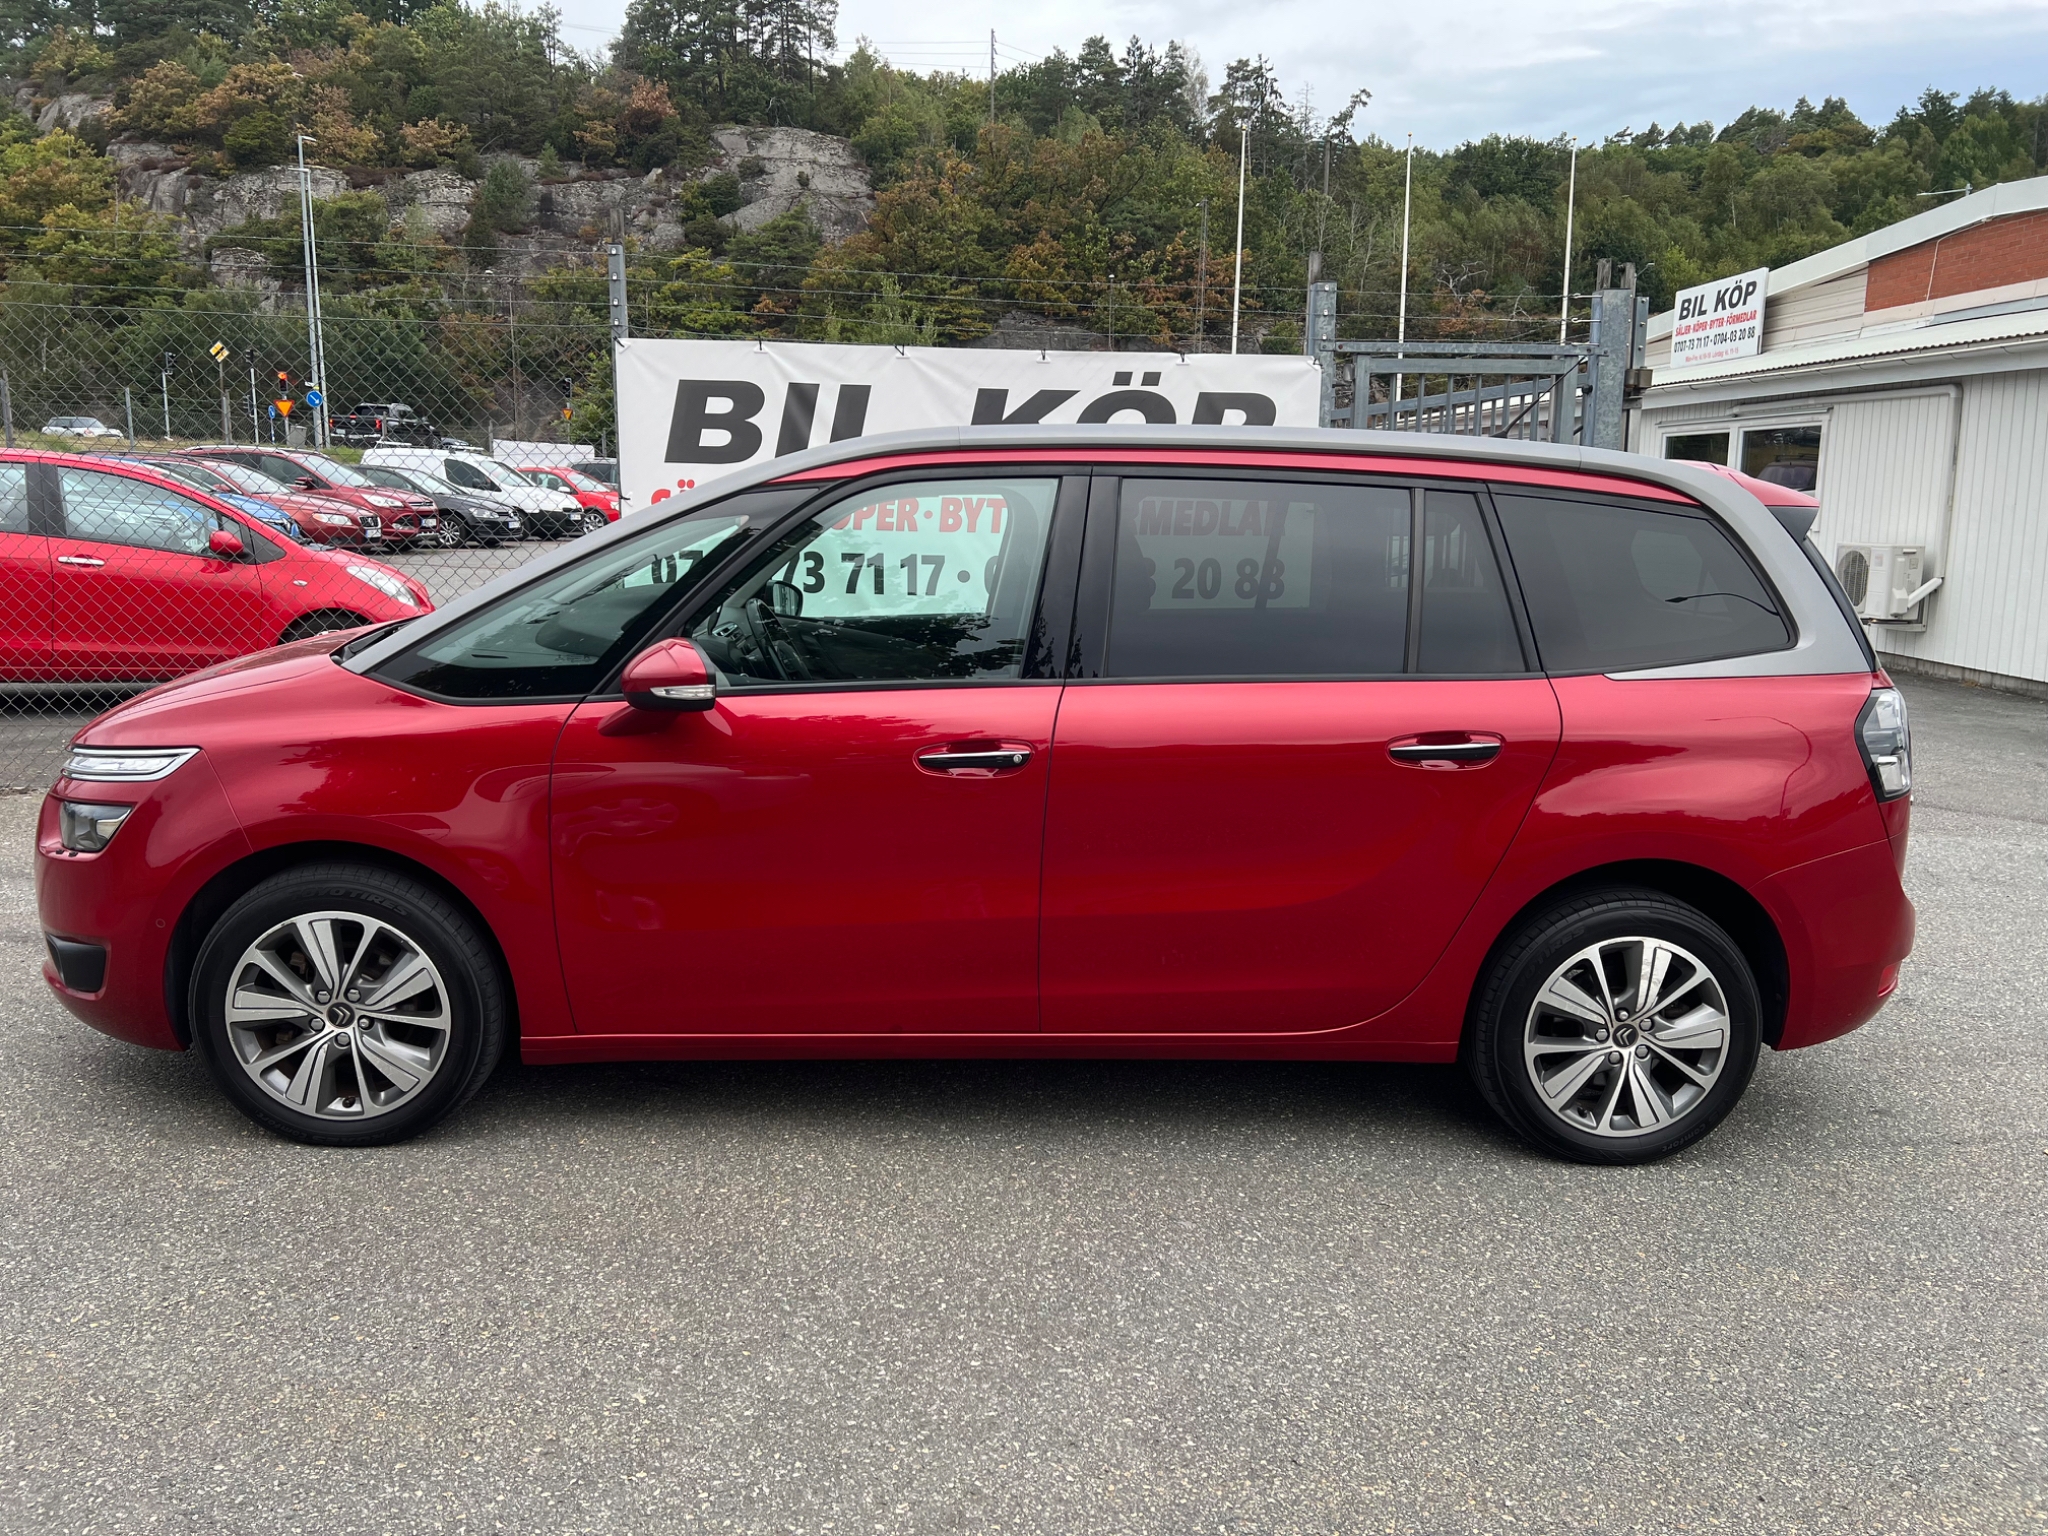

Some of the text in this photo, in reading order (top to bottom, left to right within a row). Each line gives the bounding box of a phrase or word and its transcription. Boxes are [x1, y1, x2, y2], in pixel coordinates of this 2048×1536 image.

[1679, 279, 1757, 321] BIL KÖP
[1674, 338, 1694, 353] 0707-73
[1696, 337, 1702, 350] 71
[1703, 335, 1710, 348] 17
[1738, 328, 1746, 341] 20
[1747, 326, 1755, 339] 88
[1134, 500, 1286, 536] MEDLA
[841, 552, 885, 595] 71
[900, 553, 946, 596] 17
[1171, 557, 1222, 600] 20
[349, 889, 411, 917] TIRES
